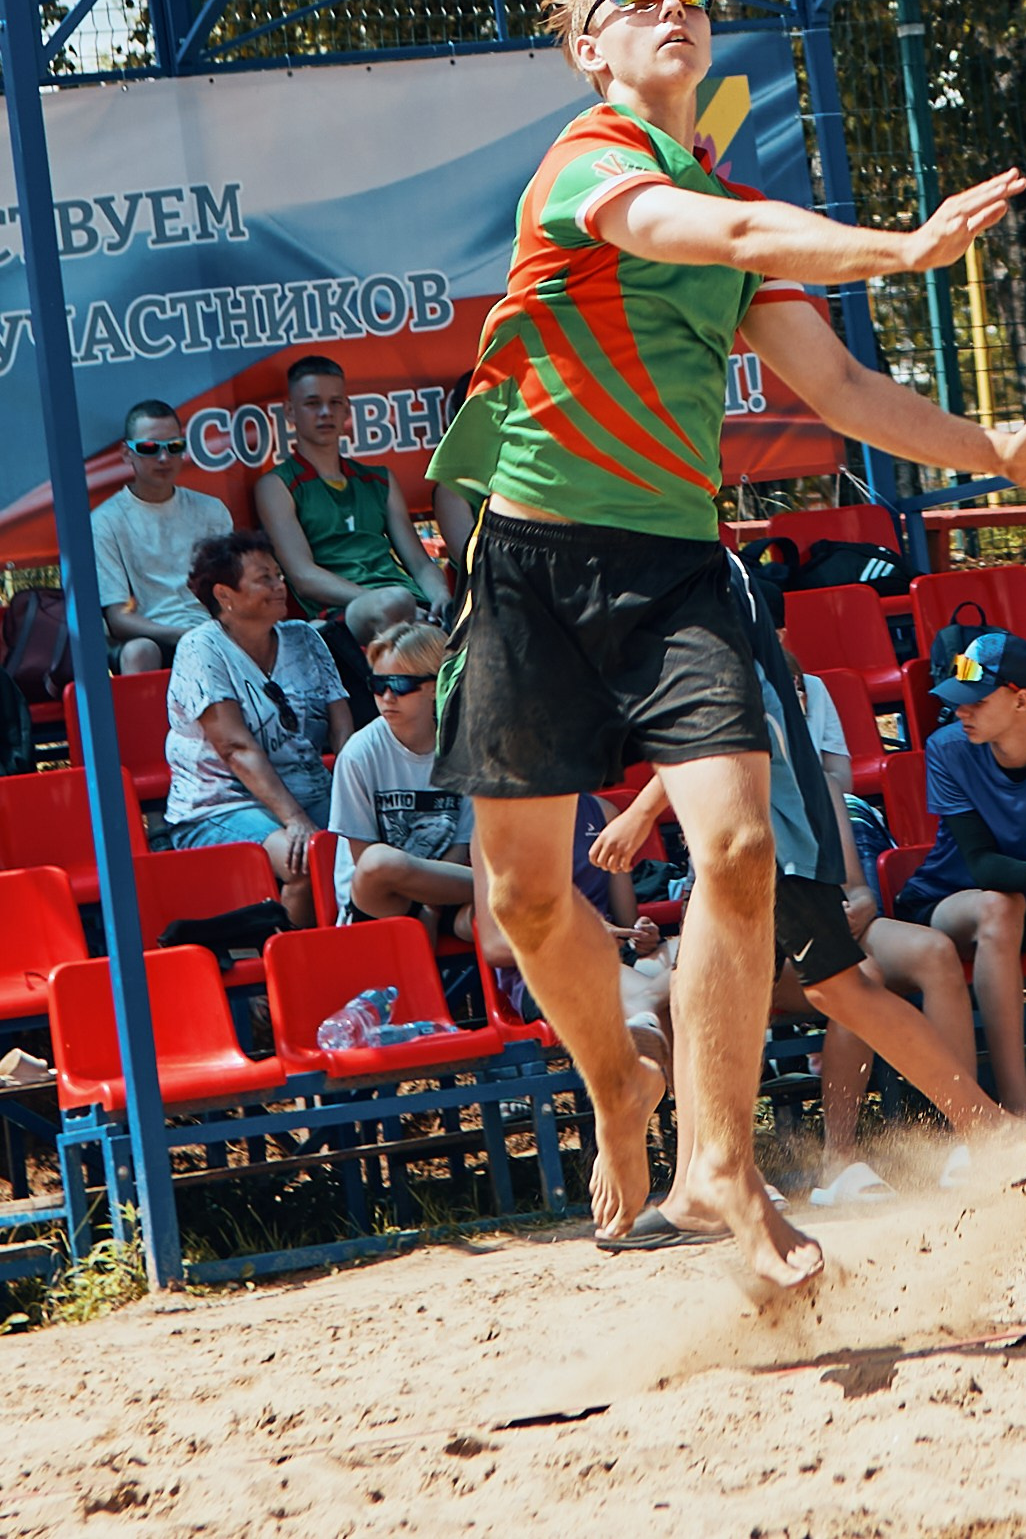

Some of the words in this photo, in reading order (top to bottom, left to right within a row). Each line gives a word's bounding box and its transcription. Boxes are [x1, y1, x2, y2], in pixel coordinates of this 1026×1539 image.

[0, 181, 249, 266] ВУЕМ
[0, 269, 455, 377] УАСТНИКОВ
[344, 515, 356, 532] 1
